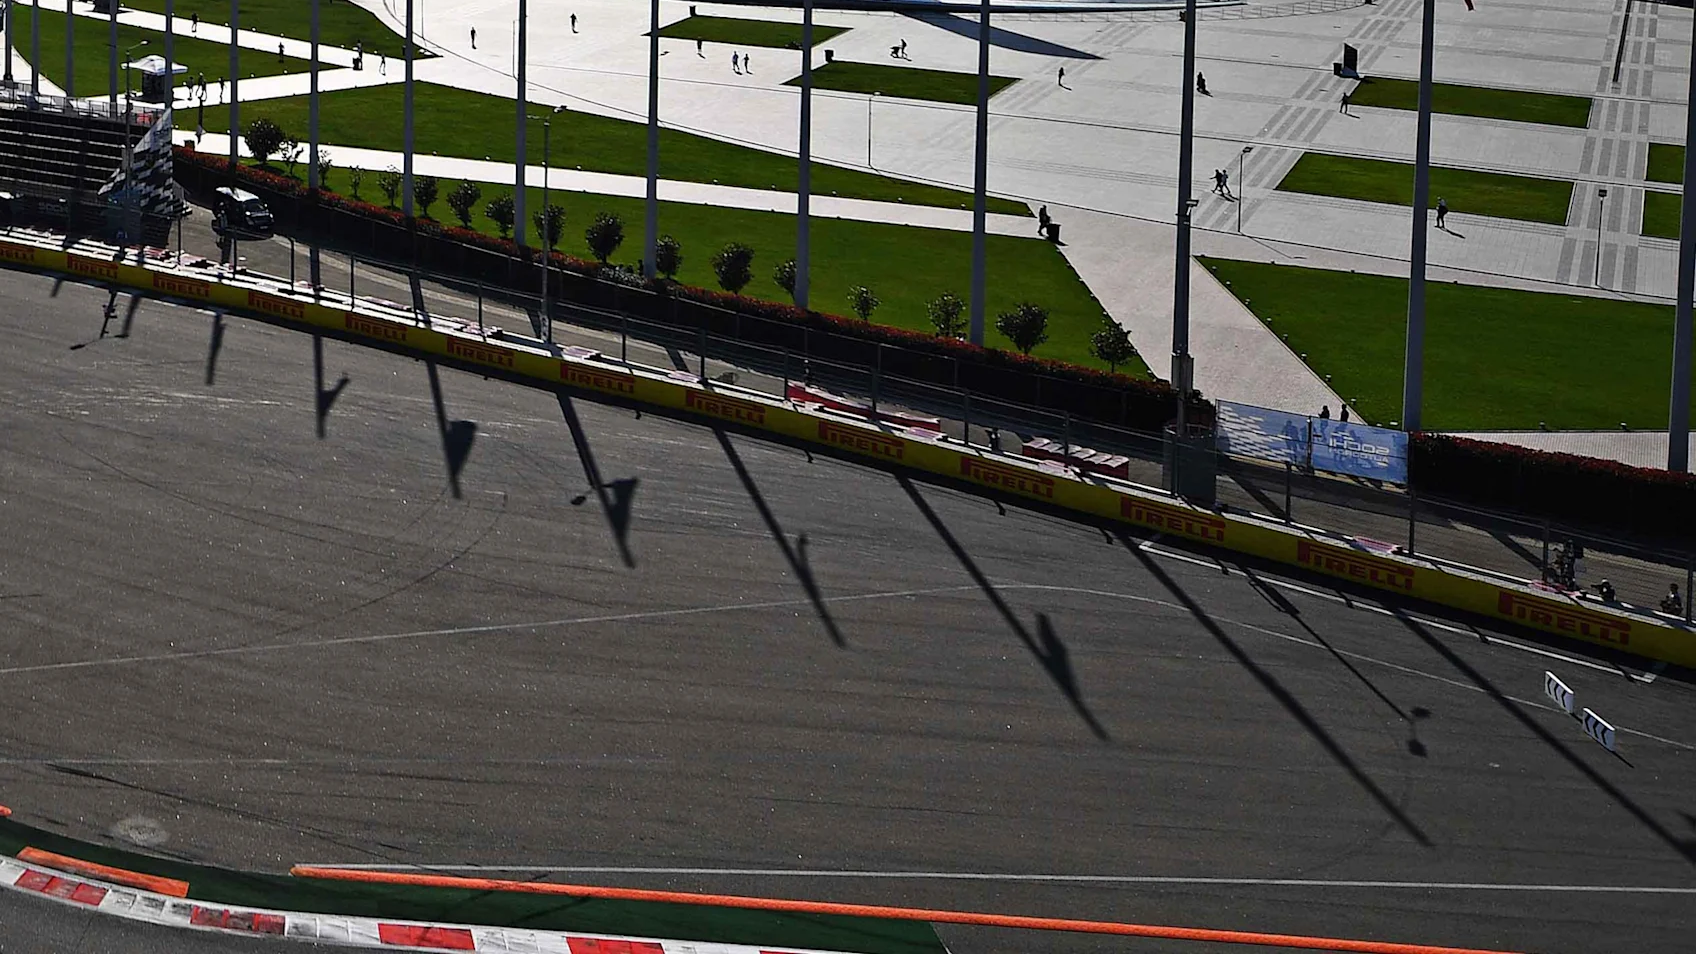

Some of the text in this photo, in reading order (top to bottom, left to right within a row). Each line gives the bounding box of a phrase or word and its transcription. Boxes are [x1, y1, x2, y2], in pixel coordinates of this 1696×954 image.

[67, 253, 118, 279] PIRELLI
[154, 273, 210, 297] PIRELLI
[248, 290, 304, 319] PIRELLI
[345, 312, 408, 341] PIRELLI
[446, 336, 514, 367] PIRELLI
[560, 361, 635, 393] PIRELLI
[685, 388, 766, 424] PIRELLI
[818, 420, 904, 459] PIRELLI
[961, 456, 1055, 498] PIRELLI
[1119, 496, 1226, 542] PIRELLI
[1297, 539, 1414, 589] PIRELLI
[1498, 590, 1631, 645] PIRELLI
